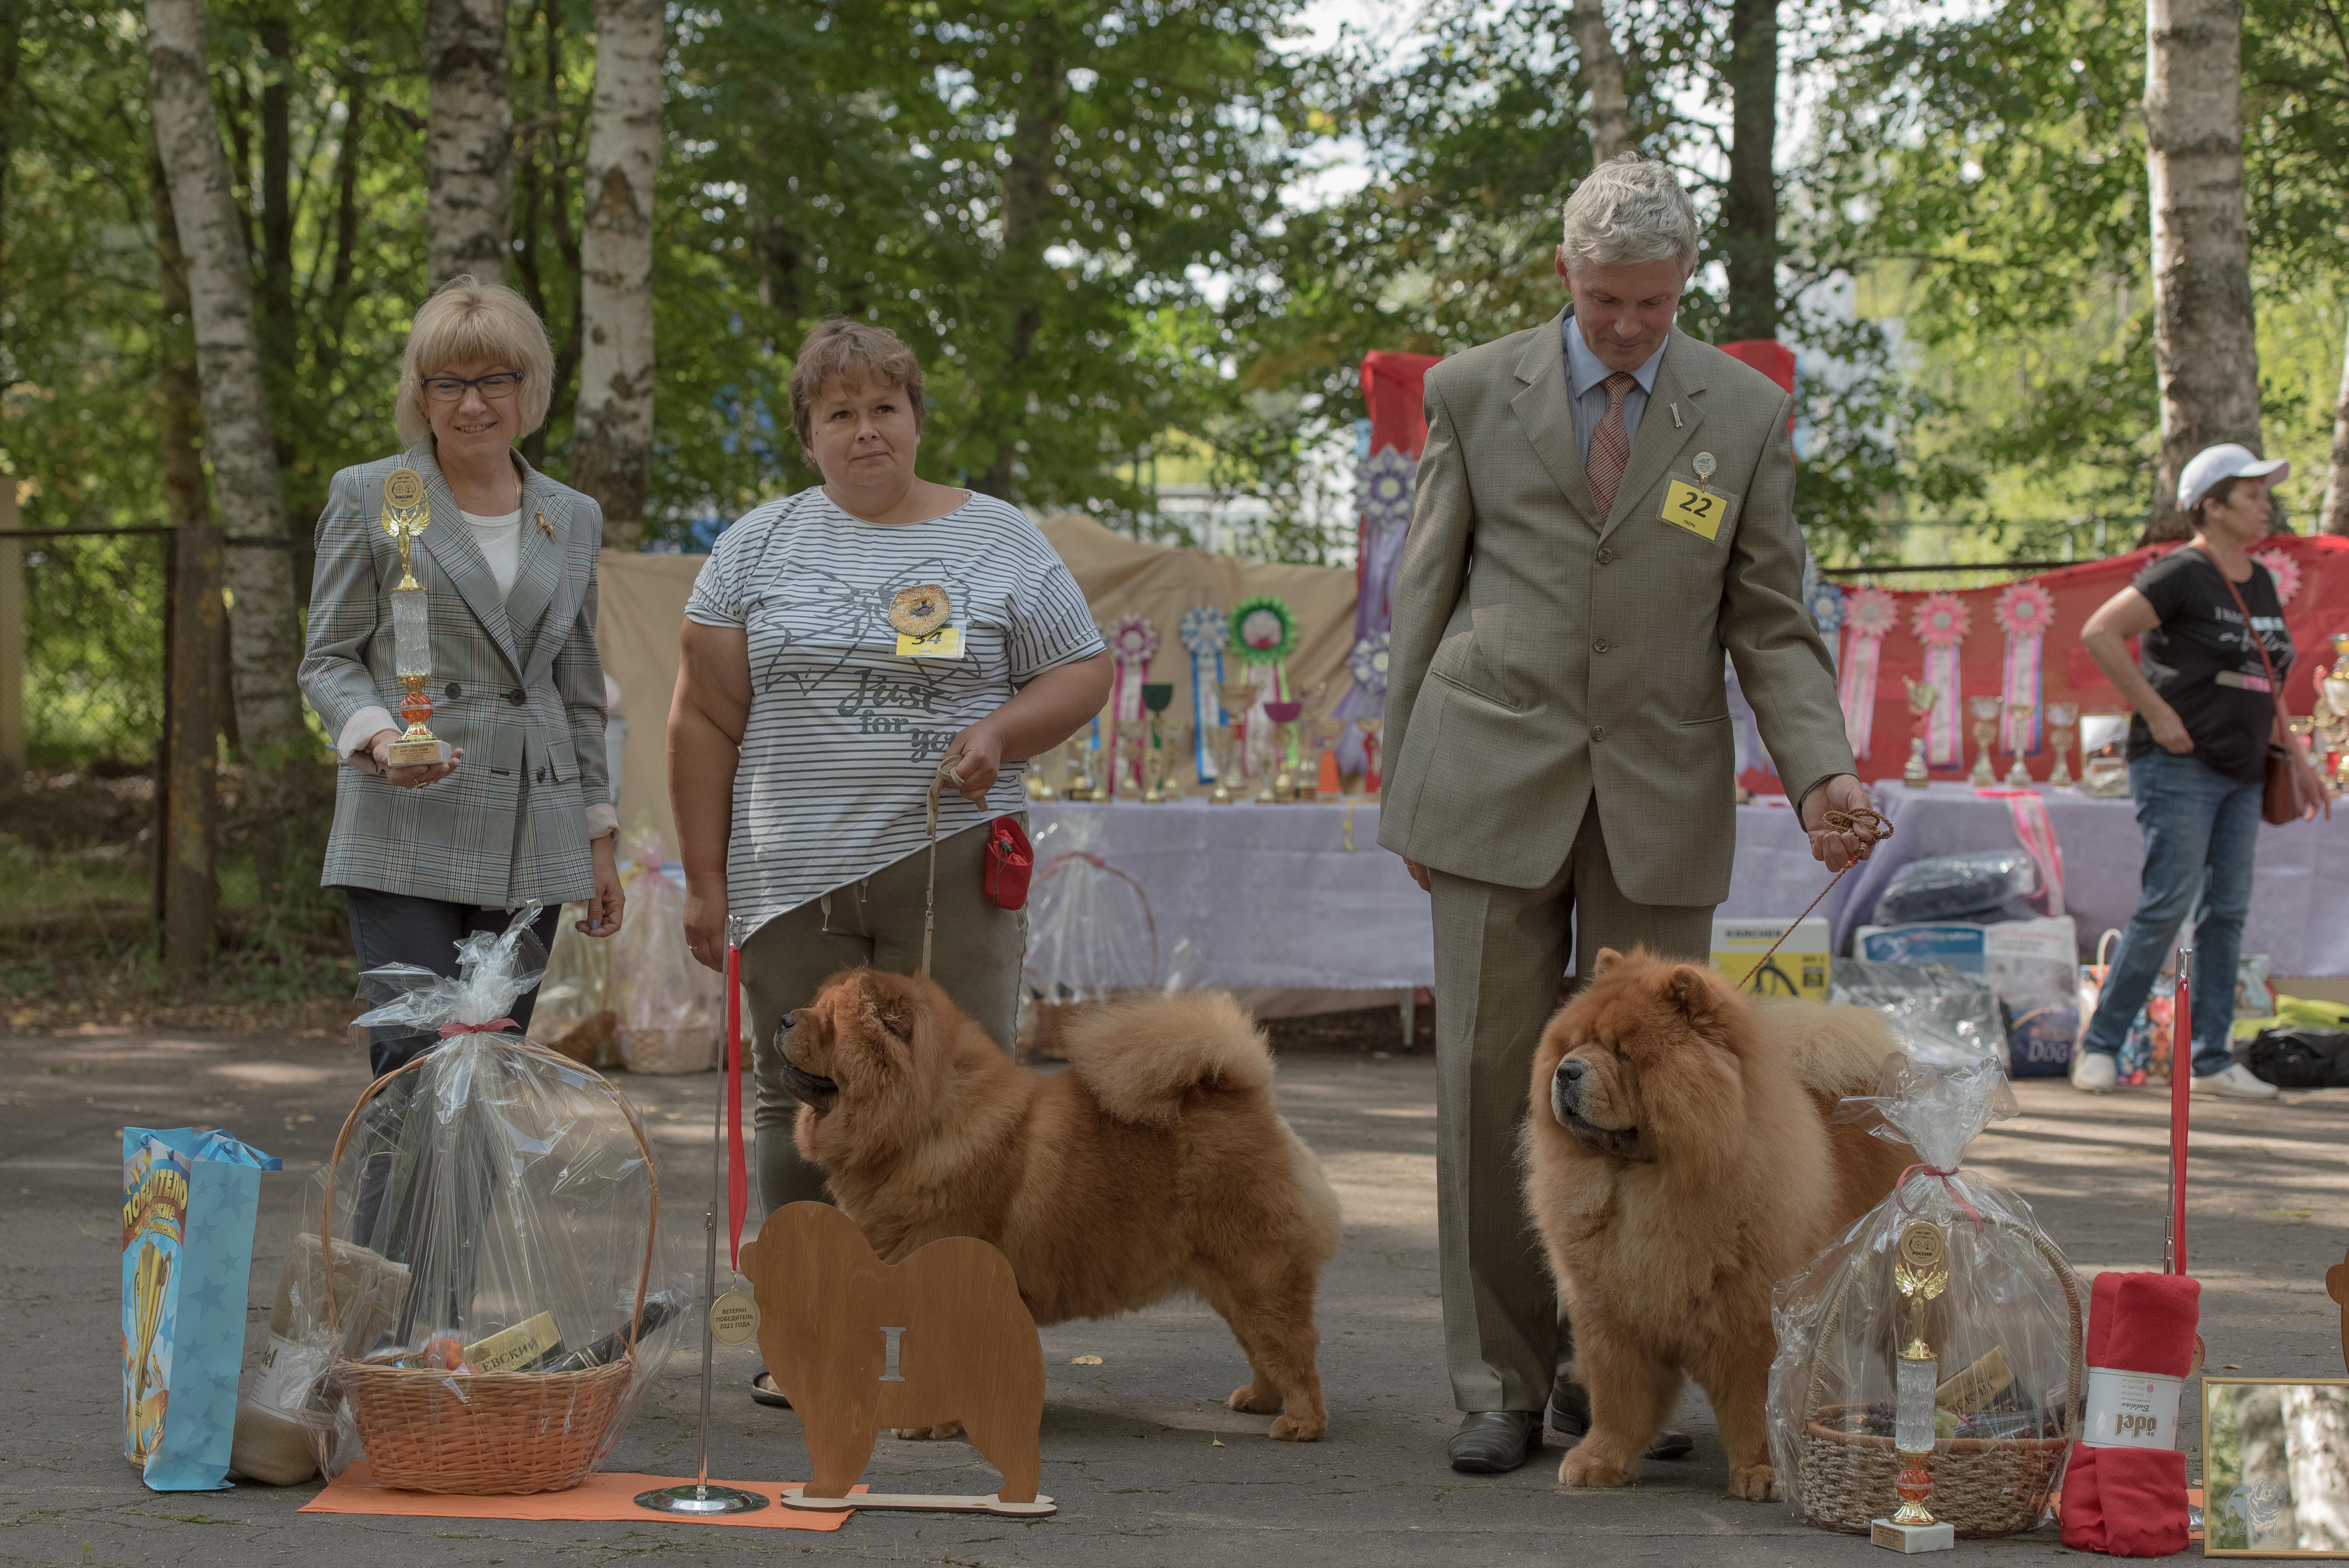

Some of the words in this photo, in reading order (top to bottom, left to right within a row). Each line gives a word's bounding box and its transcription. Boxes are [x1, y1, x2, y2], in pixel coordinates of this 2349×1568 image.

[1679, 492, 1713, 518] 22
[1683, 519, 1696, 528] ТВЕРЬ
[837, 669, 952, 716] Just
[859, 709, 909, 734] for
[909, 727, 957, 762] yo
[2029, 1039, 2069, 1063] DOG
[716, 1314, 753, 1322] ПОБЕДИТЕЛЬ
[262, 1343, 279, 1370] del
[482, 1337, 538, 1372] ЕВСКИЙ
[879, 1326, 907, 1381] I
[2122, 1403, 2149, 1412] Buldan
[2114, 1413, 2157, 1438] ödel
